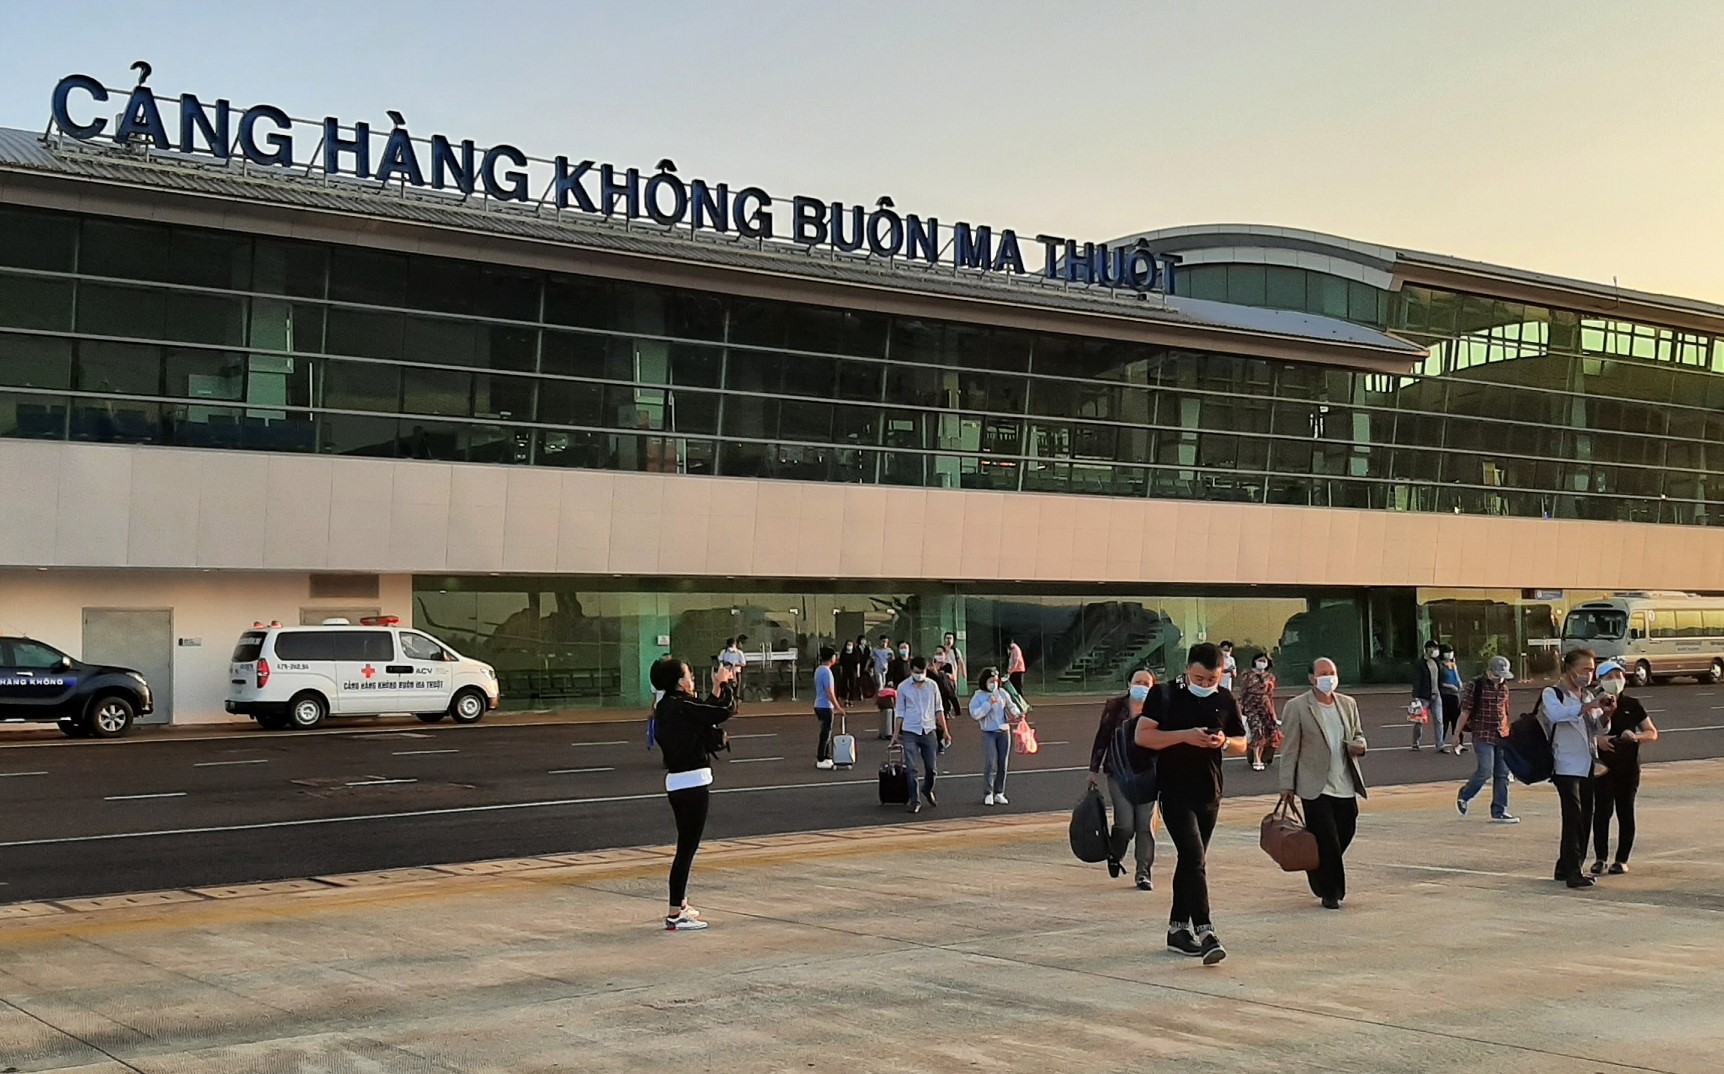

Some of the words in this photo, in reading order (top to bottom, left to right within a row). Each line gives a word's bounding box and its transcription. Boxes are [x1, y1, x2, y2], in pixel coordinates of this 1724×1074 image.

[51, 61, 293, 169] CẢNG
[323, 110, 528, 202] HÀNG
[555, 155, 772, 238] KHÔNG
[793, 195, 939, 265] BUÔN
[954, 221, 1026, 275] MA
[1036, 234, 1184, 301] THUỘT
[416, 667, 433, 675] ACV
[29, 677, 64, 686] KHÔNG
